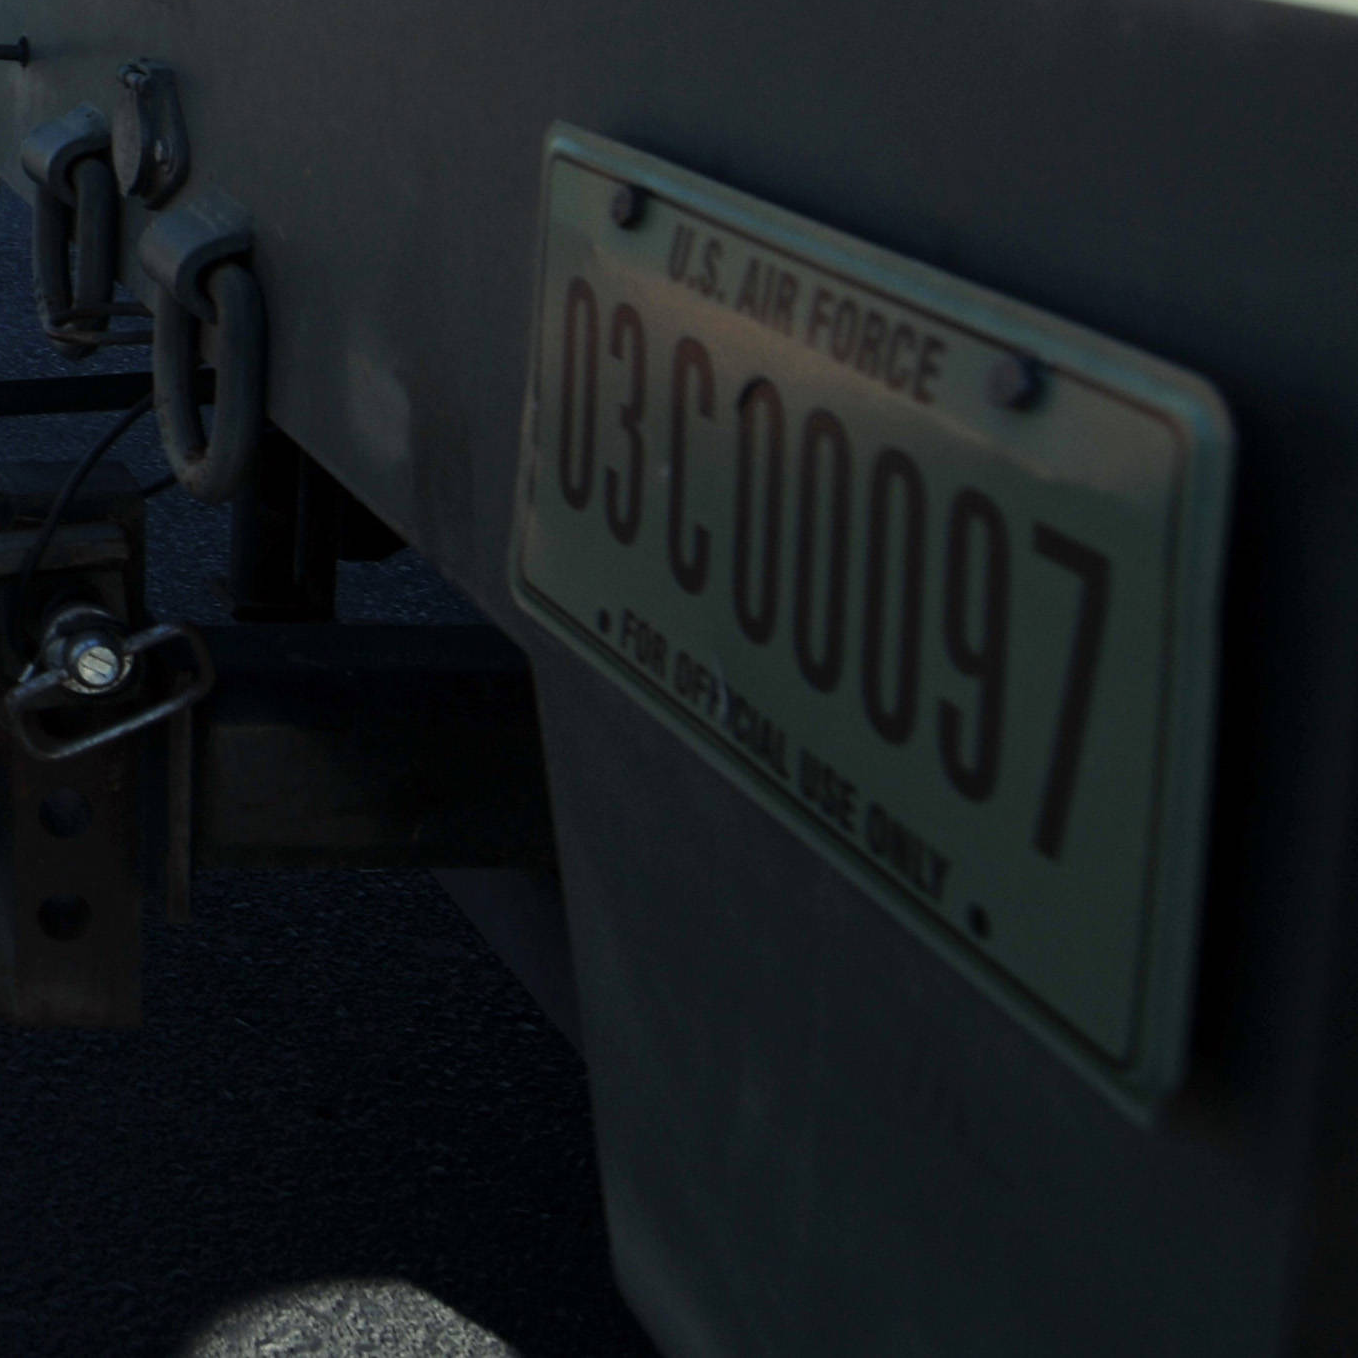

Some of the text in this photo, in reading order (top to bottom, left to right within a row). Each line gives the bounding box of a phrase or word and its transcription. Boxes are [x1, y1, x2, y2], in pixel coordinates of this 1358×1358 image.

[668, 222, 947, 407] U.S. AIR FORCE
[557, 277, 1112, 862] 03C00097
[621, 608, 667, 680] FOR
[799, 746, 856, 832] USE
[866, 801, 952, 900] ONLY
